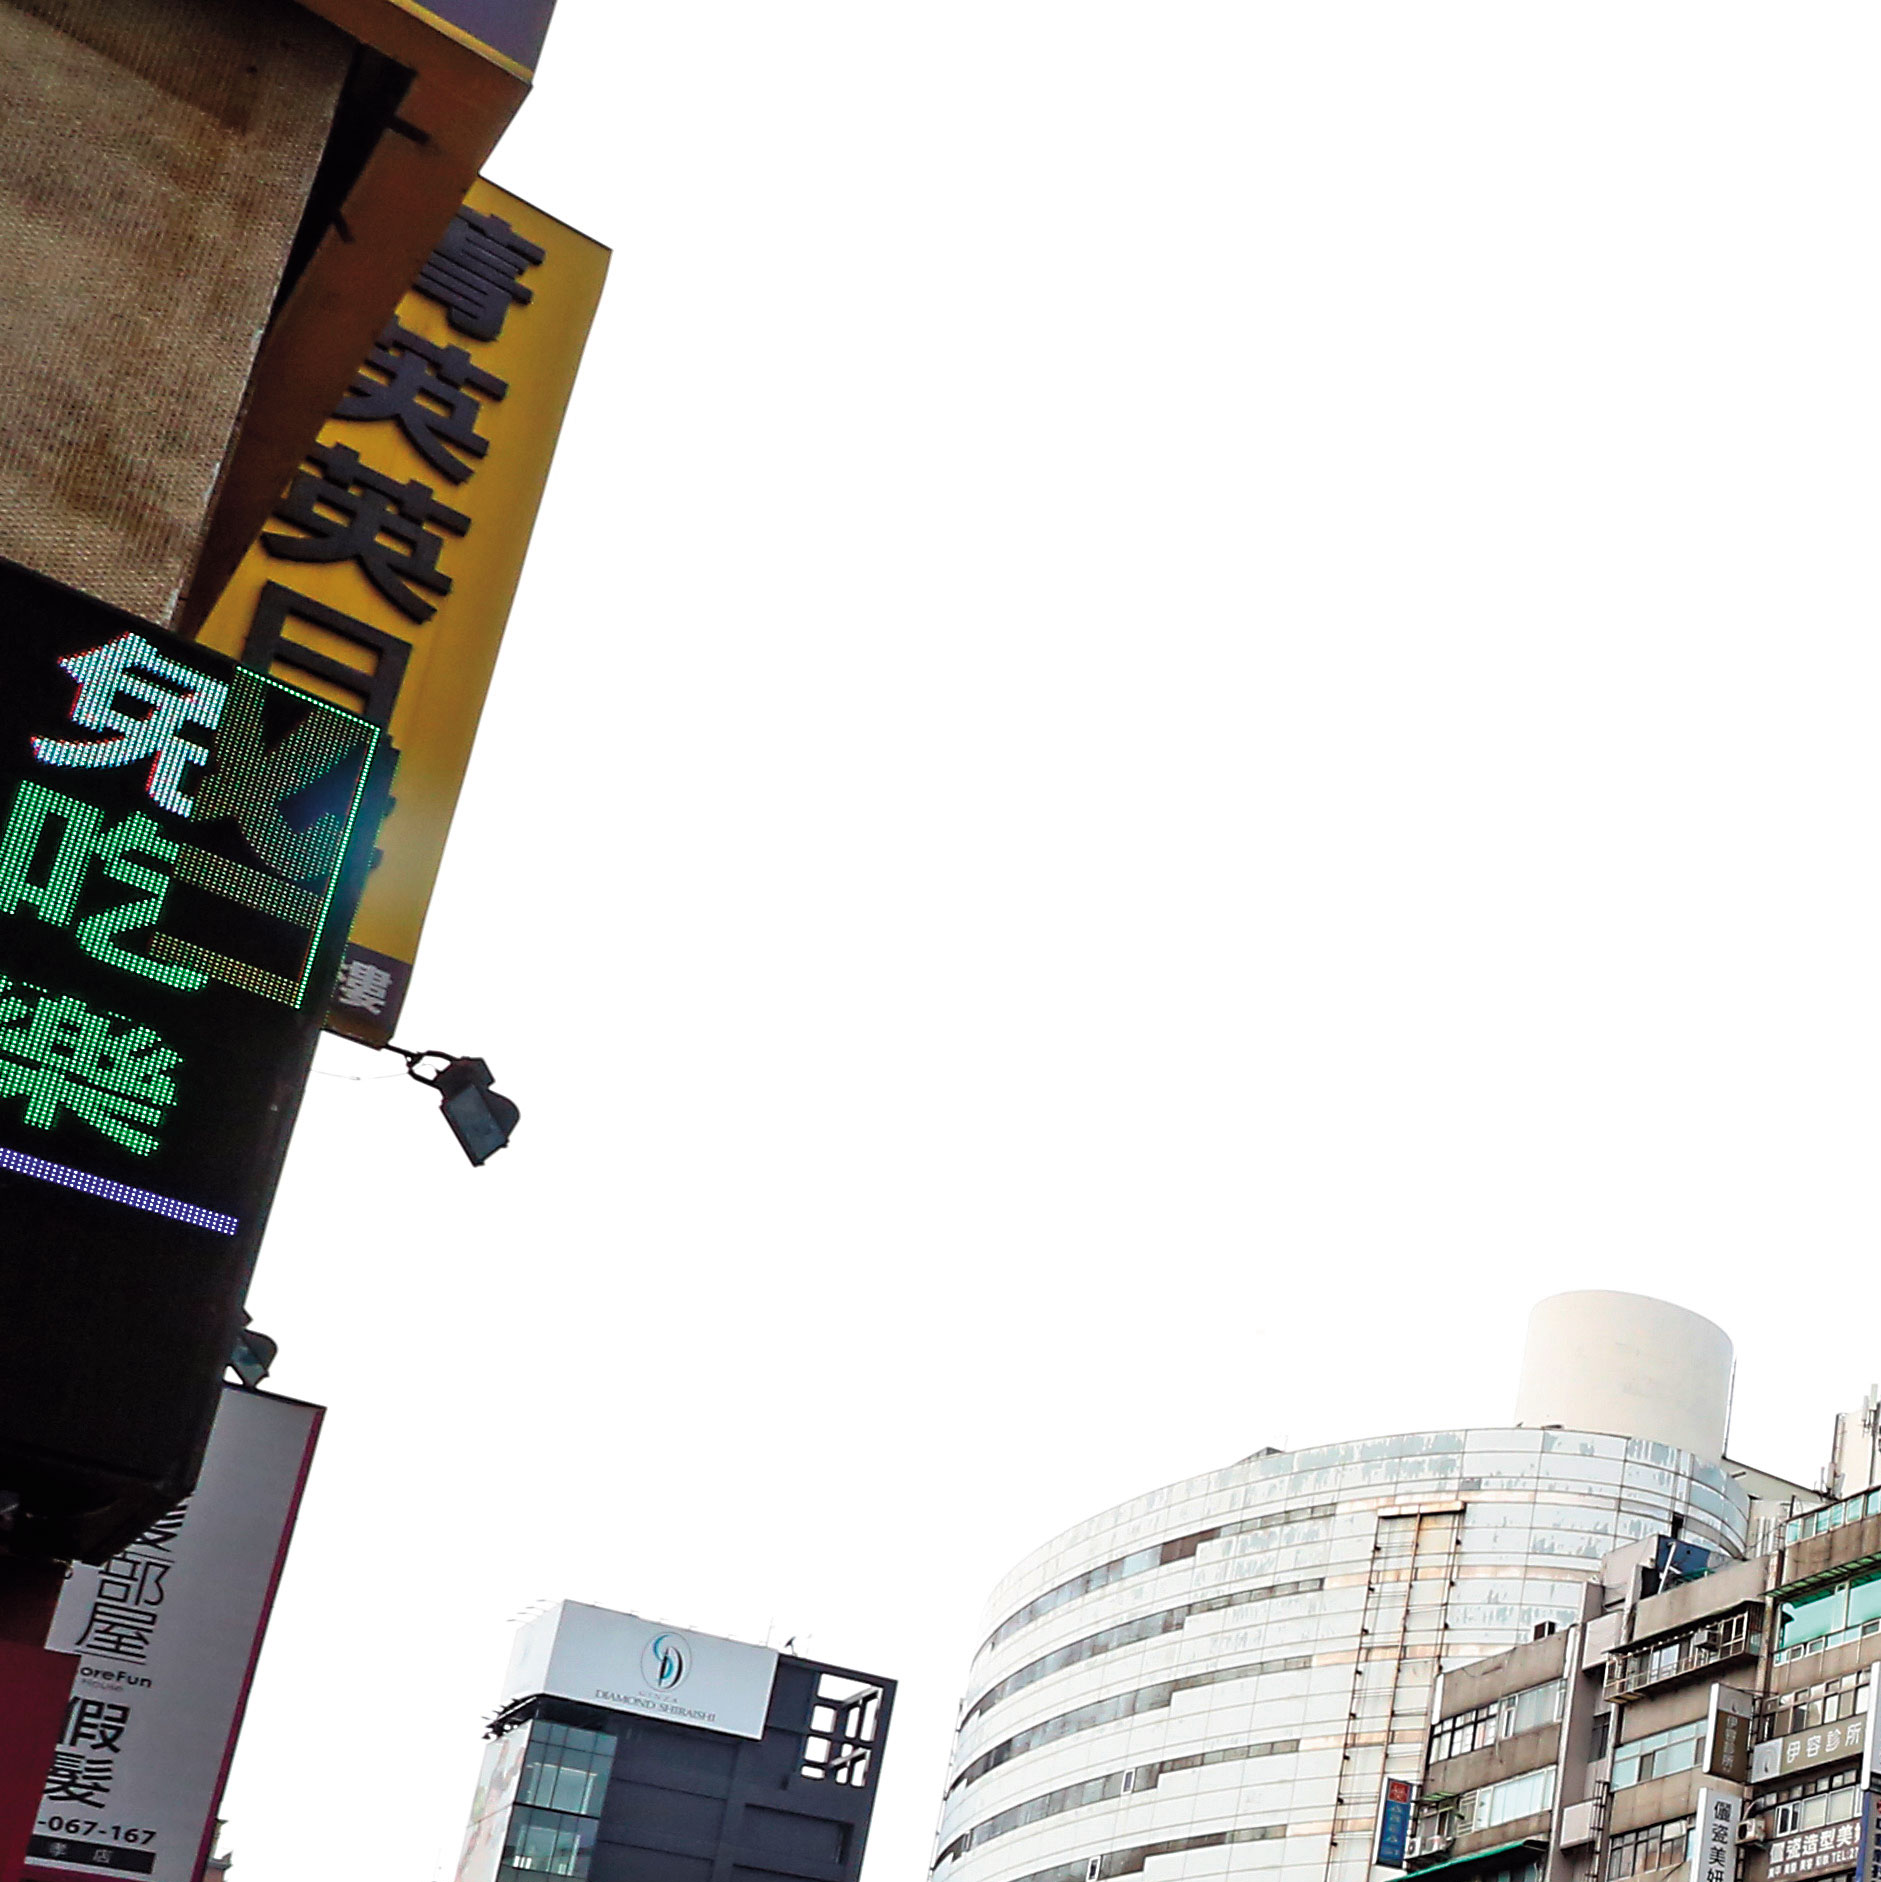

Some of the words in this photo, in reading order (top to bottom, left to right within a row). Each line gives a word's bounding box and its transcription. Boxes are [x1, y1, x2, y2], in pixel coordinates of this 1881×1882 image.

[80, 1665, 152, 1689] oreFun
[594, 1689, 656, 1710] DIAMOND
[659, 1703, 717, 1723] SHIRAISHI
[1786, 1721, 1864, 1765] 伊容診所
[38, 1815, 156, 1846] -067-167
